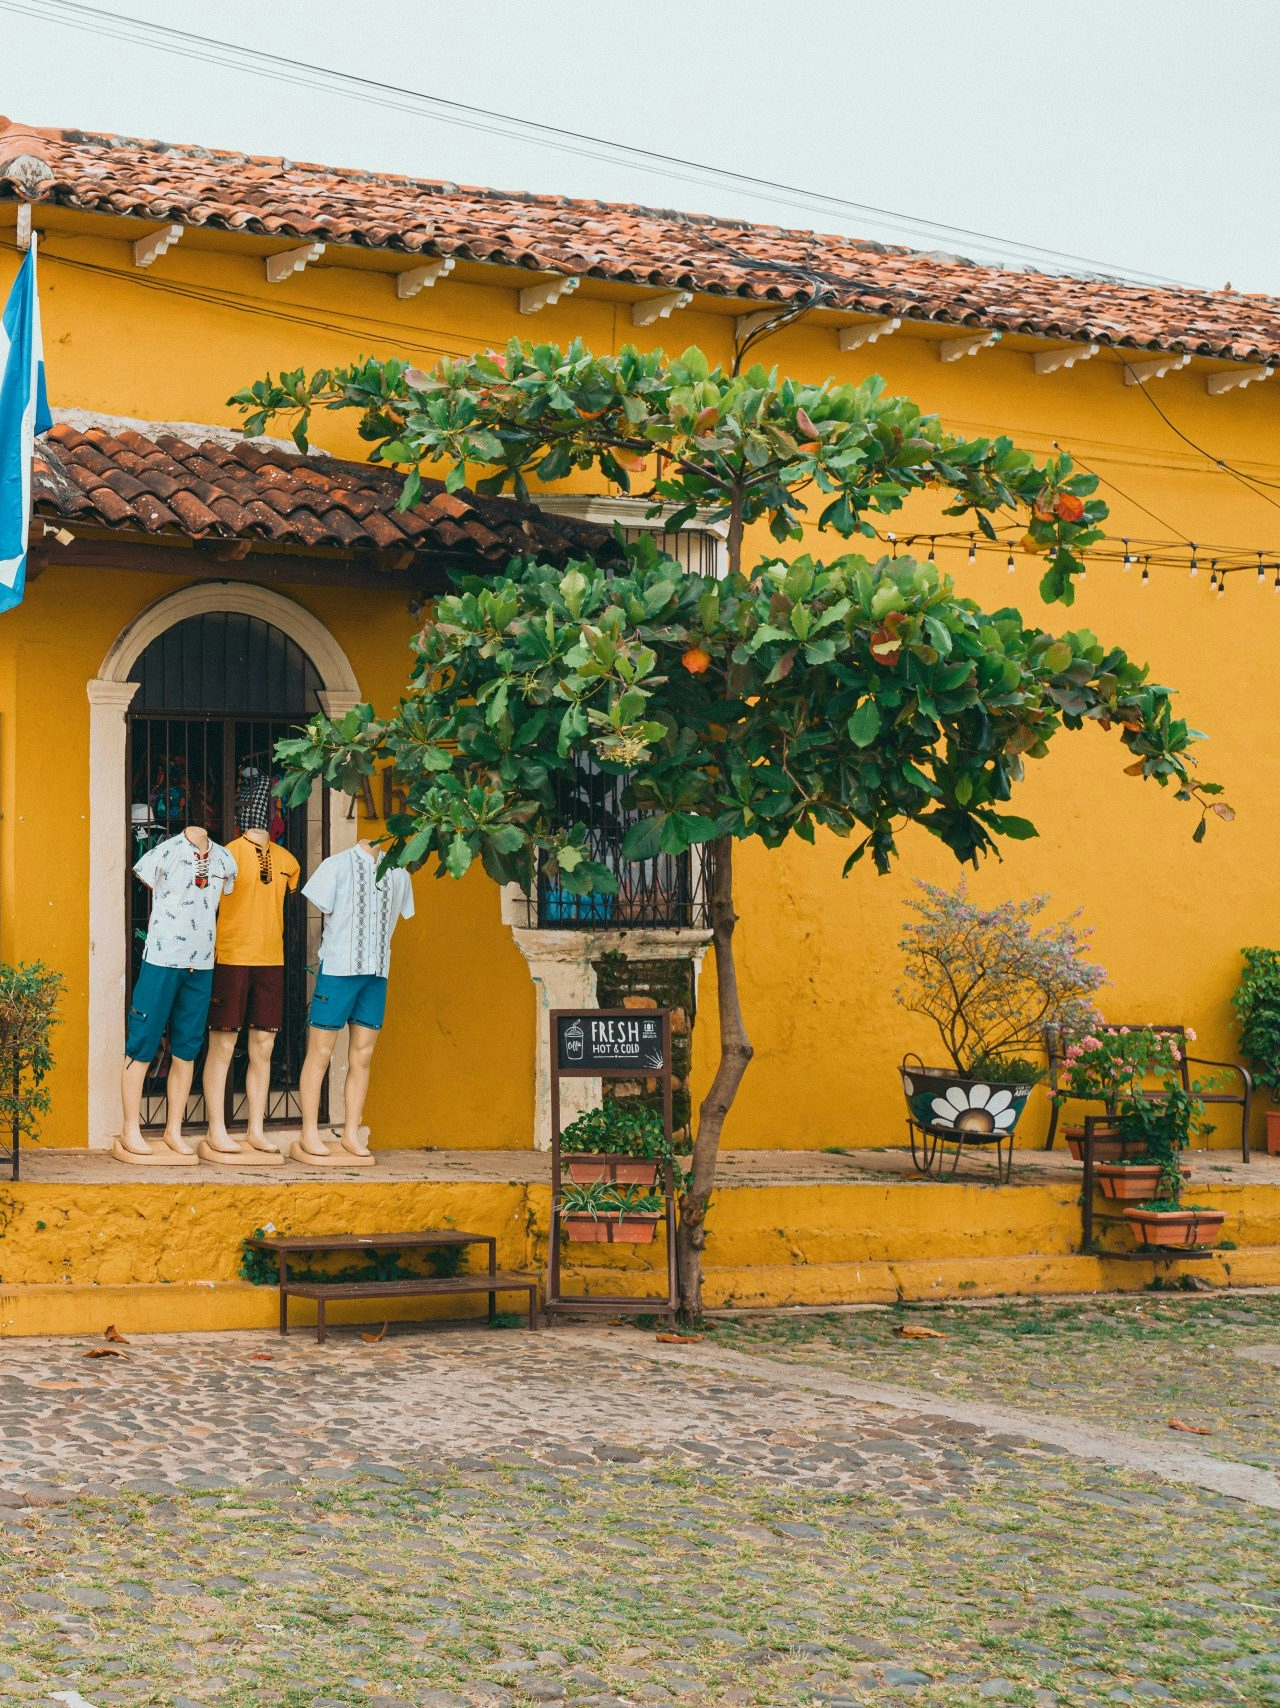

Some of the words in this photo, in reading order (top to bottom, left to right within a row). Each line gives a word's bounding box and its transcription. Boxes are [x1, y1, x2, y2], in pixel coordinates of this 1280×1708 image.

[591, 1021, 640, 1043] FRESH
[592, 1044, 611, 1053] HOT
[614, 1044, 619, 1053] &
[621, 1044, 640, 1053] COLD
